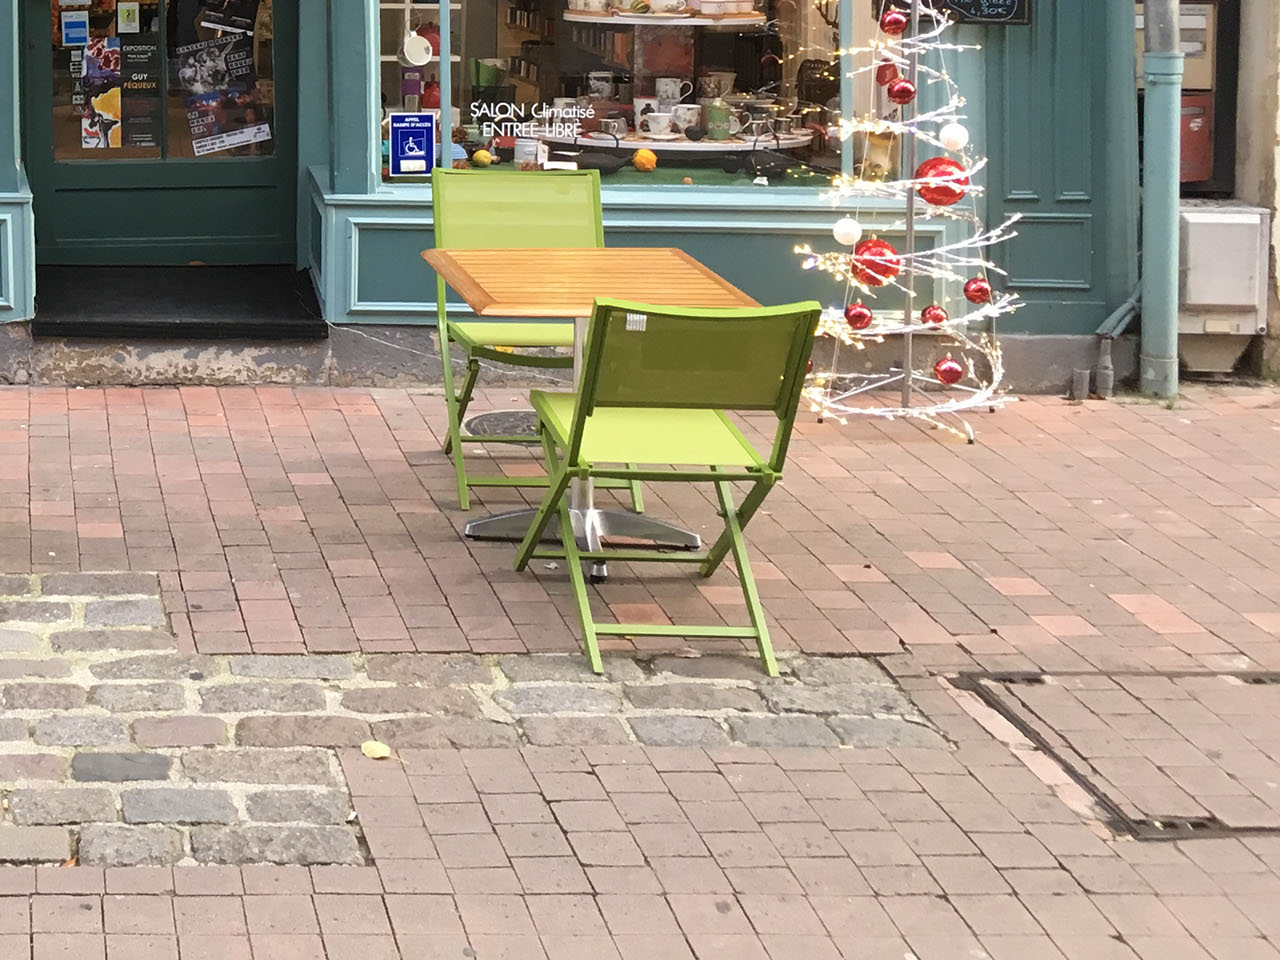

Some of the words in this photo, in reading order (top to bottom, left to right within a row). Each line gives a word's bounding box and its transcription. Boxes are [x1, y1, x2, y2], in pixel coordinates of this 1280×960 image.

[470, 103, 524, 118] SALON
[531, 102, 595, 119] Climatisé
[483, 122, 538, 137] ENTREE
[546, 122, 582, 138] LIBRE
